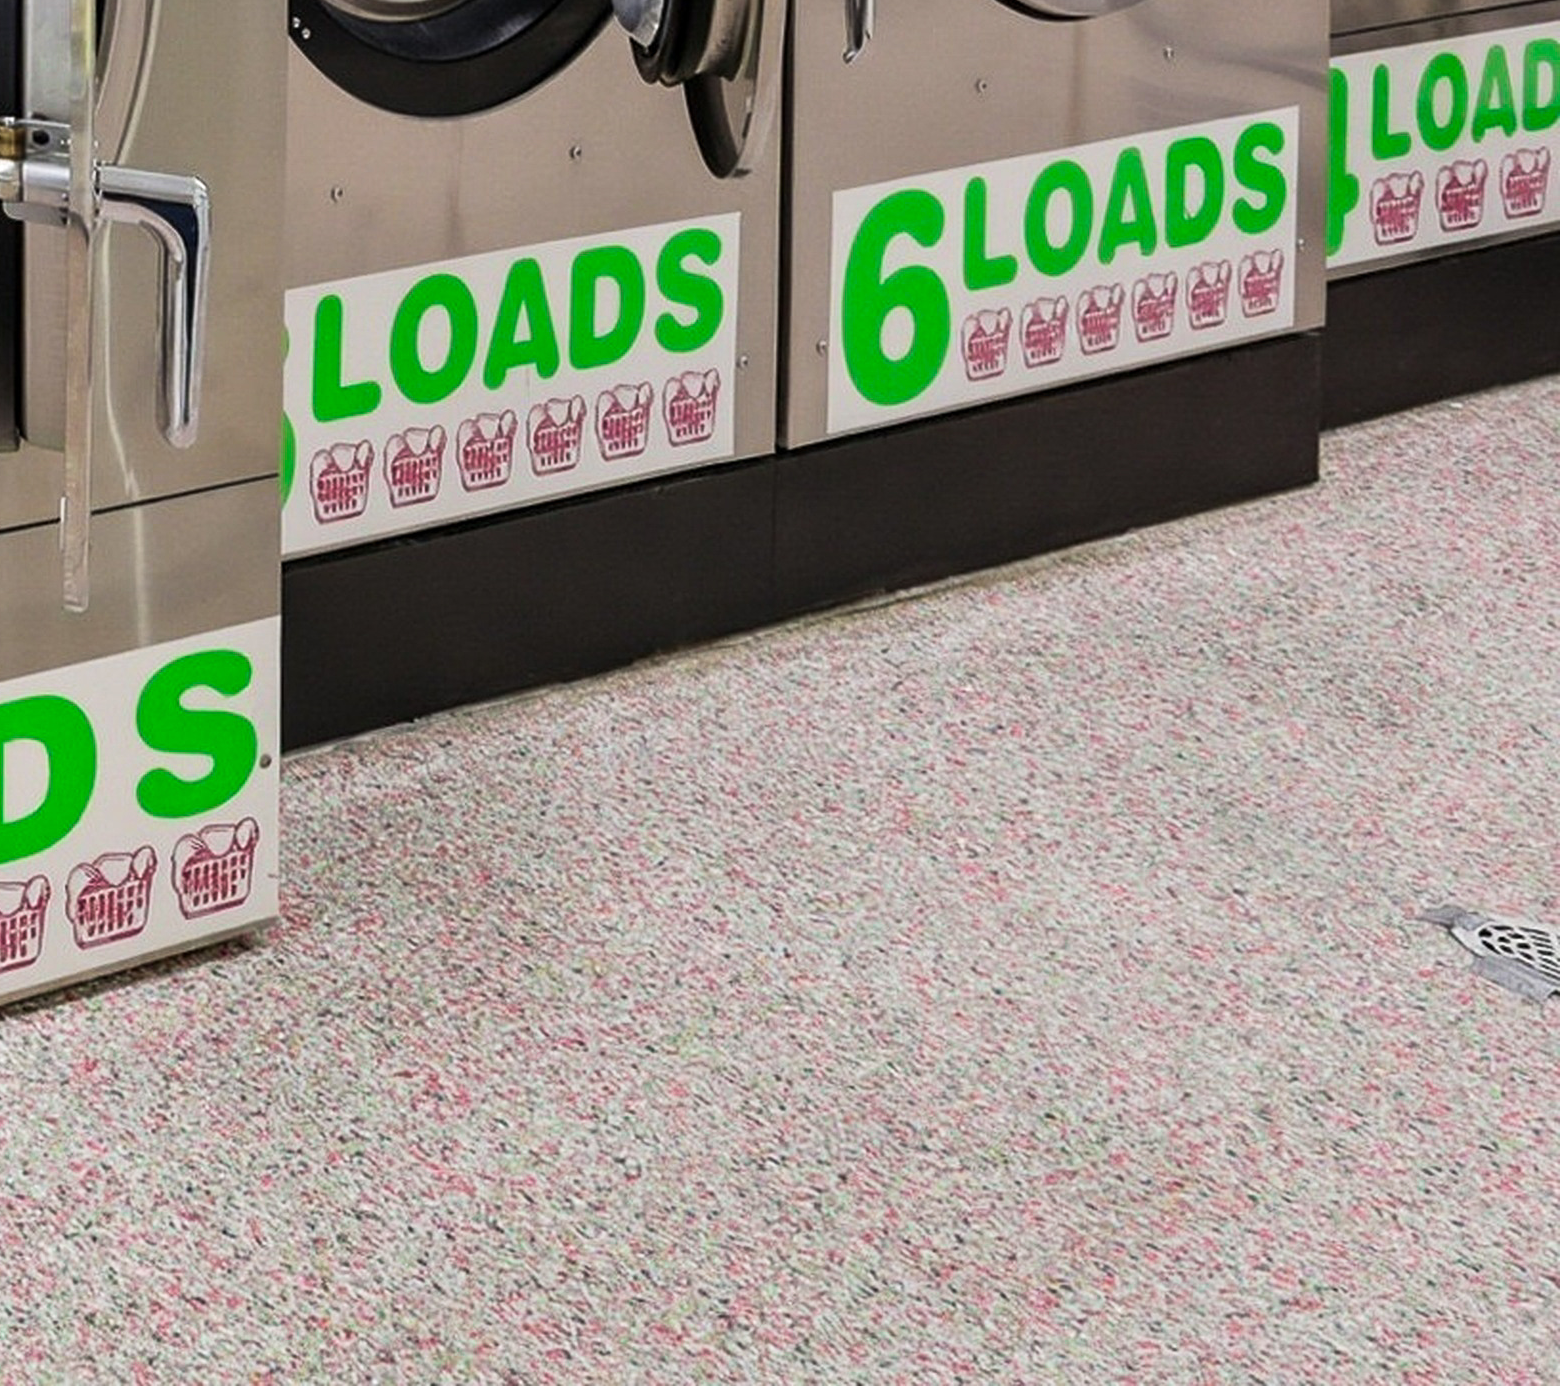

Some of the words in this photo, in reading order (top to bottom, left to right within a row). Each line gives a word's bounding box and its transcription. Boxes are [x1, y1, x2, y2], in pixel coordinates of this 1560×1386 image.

[311, 228, 725, 424] LOADS
[841, 188, 951, 406] 6
[963, 122, 1287, 292] LOADS
